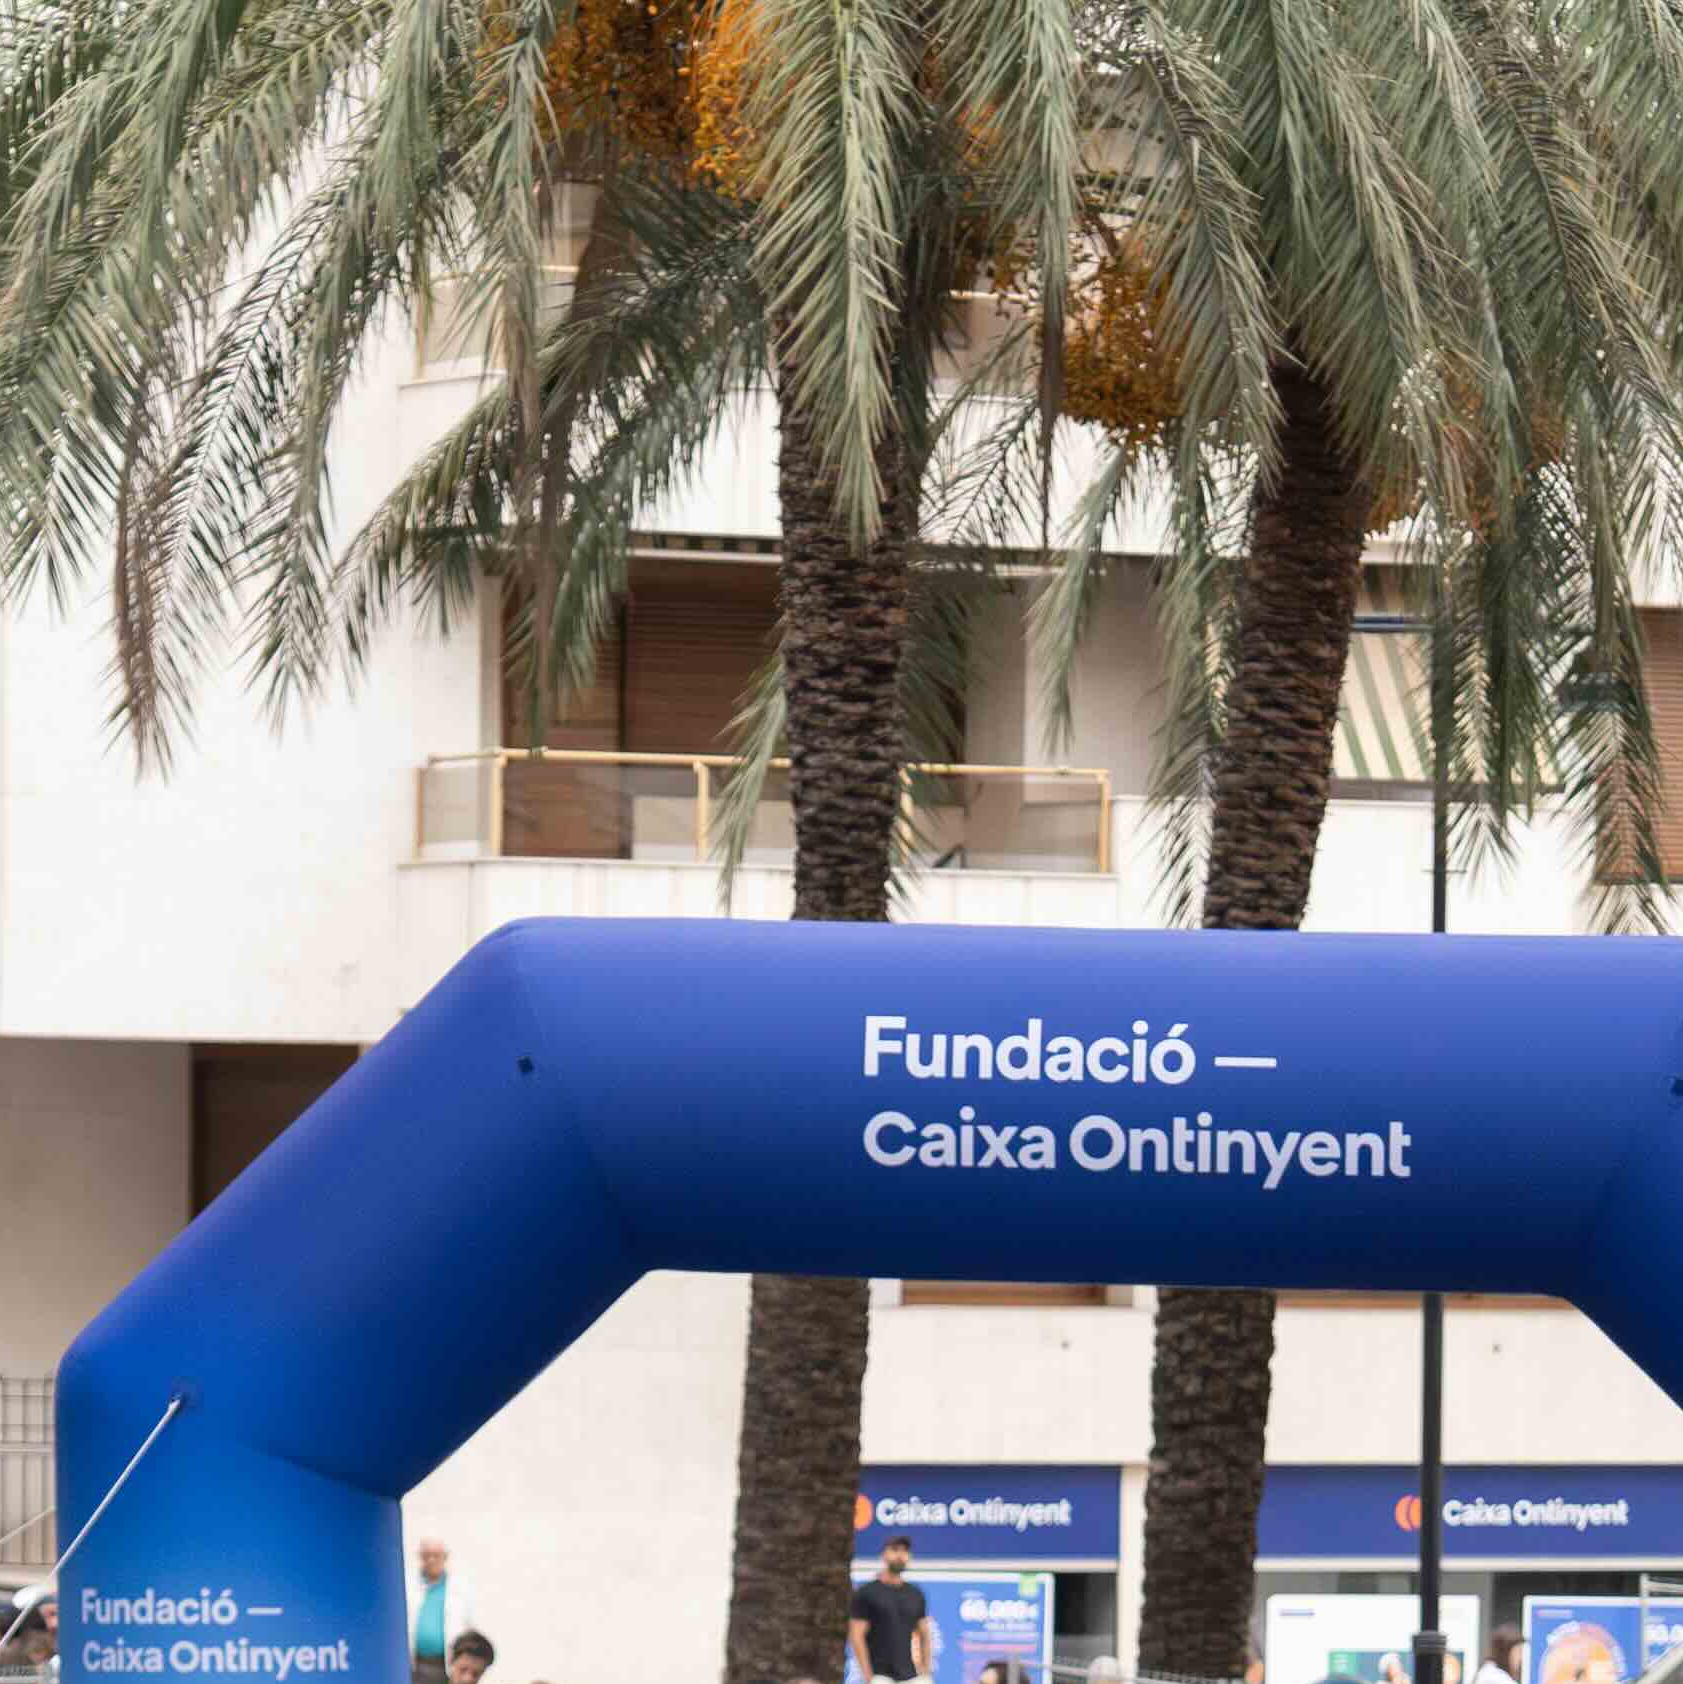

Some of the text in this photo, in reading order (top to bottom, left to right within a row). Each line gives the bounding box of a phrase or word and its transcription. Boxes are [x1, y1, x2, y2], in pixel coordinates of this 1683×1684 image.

[863, 1015, 1196, 1085] Fundació
[863, 1106, 1412, 1189] Caixa Ontinyent
[876, 1496, 1072, 1533] Caixa Ontinyent
[1443, 1497, 1629, 1531] Caixa Ontinyent
[81, 1587, 238, 1626] Fundació
[82, 1637, 350, 1681] Caixa Ontinyent
